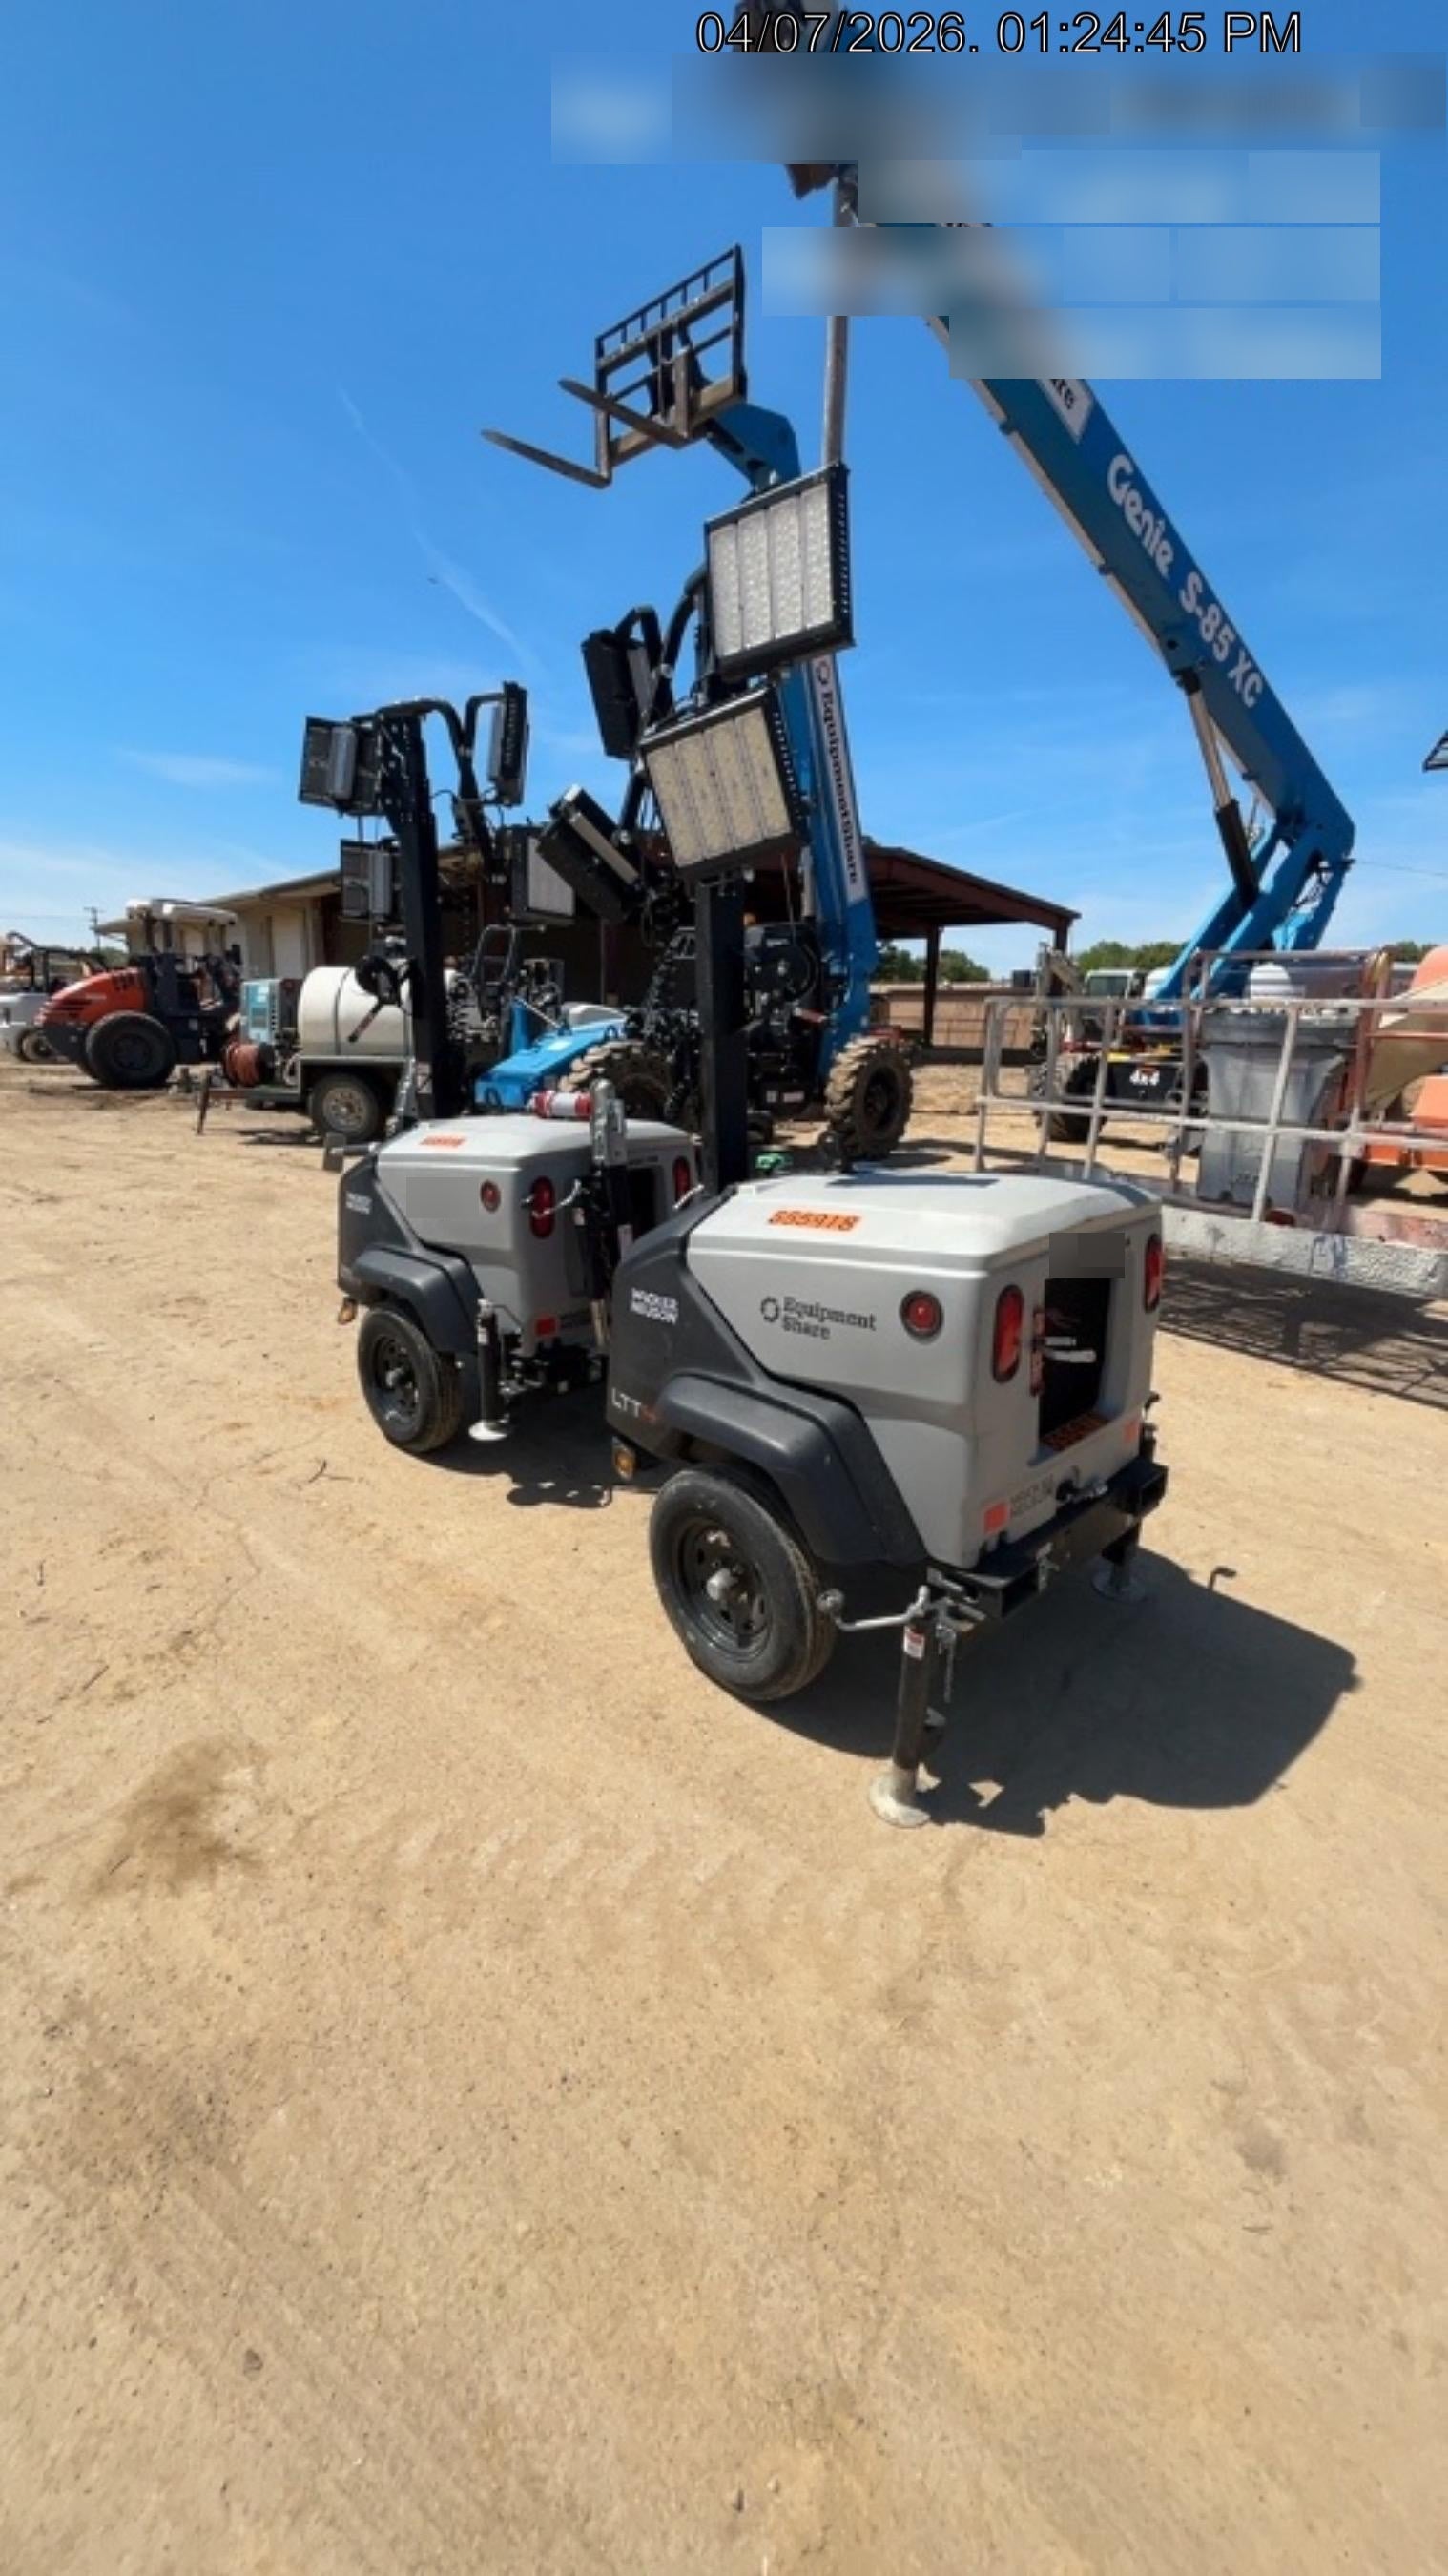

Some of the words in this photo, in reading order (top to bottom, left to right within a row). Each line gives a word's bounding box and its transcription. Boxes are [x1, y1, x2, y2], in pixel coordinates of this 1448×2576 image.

[1107, 453, 1175, 580] Genie
[1179, 571, 1236, 662] S-85
[1227, 648, 1264, 708] XC
[821, 691, 857, 885] EquipmentShare
[782, 1296, 877, 1331] Equipment
[782, 1316, 831, 1340] Share
